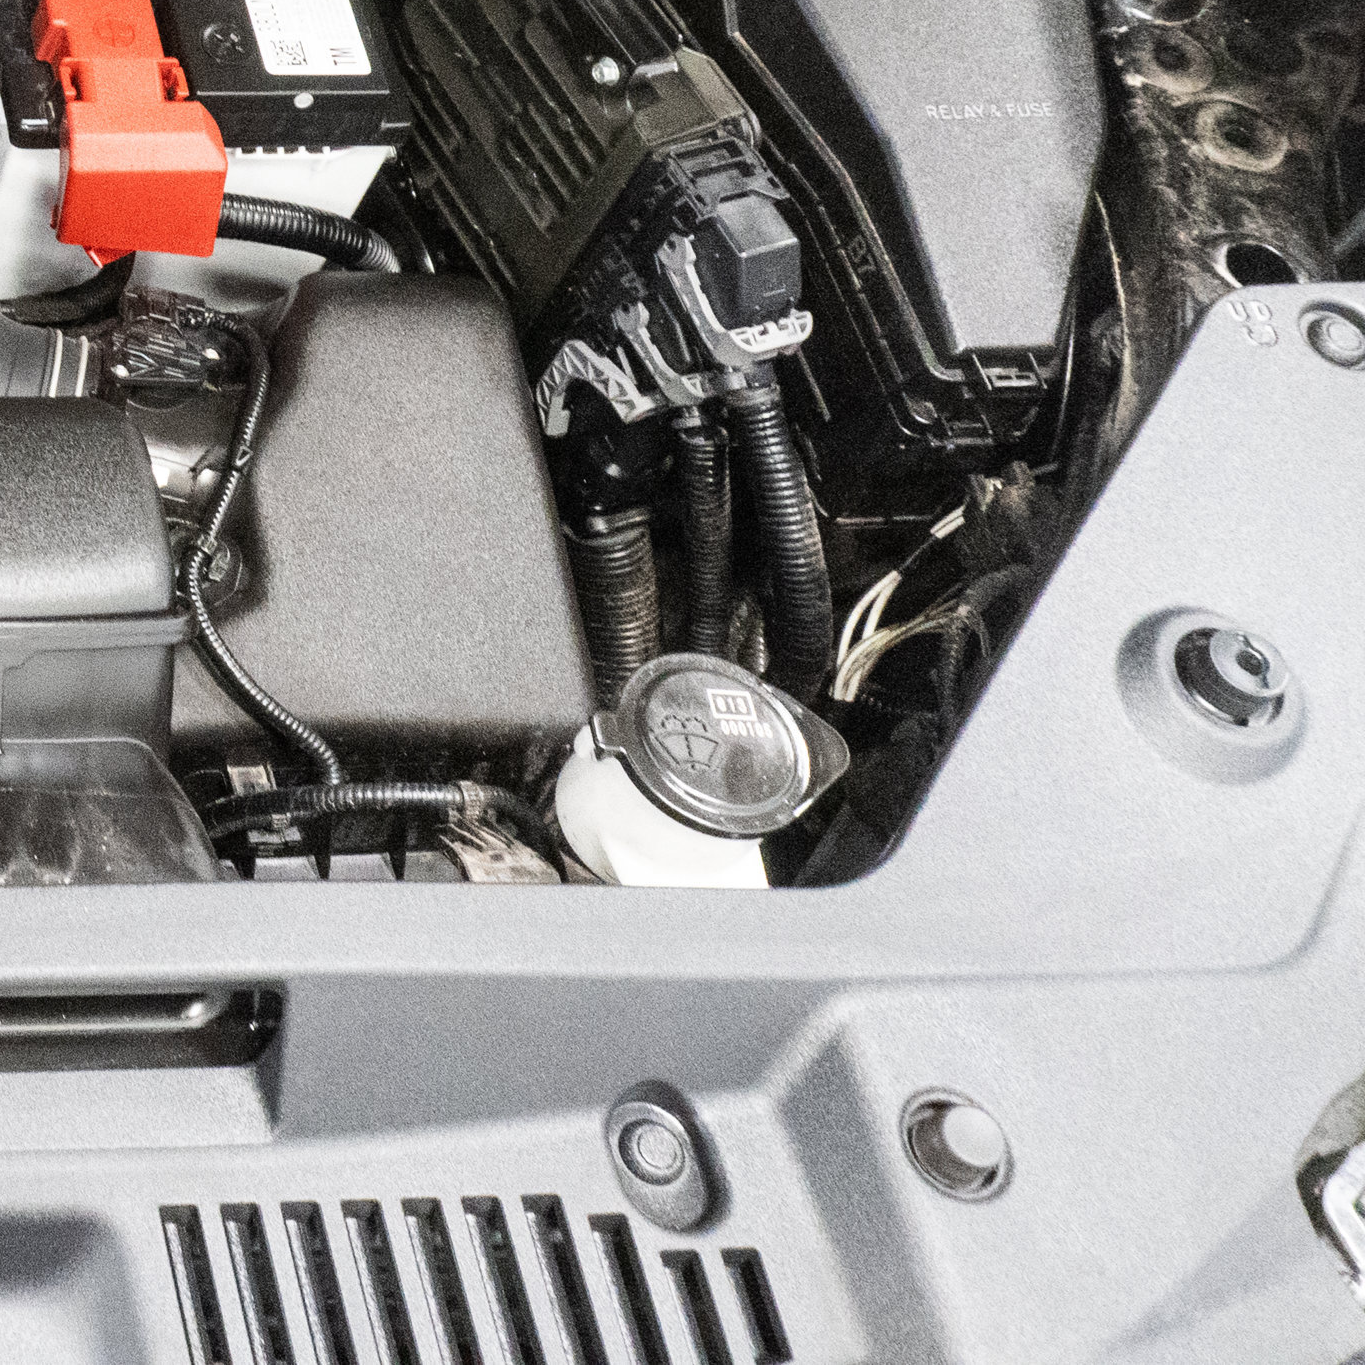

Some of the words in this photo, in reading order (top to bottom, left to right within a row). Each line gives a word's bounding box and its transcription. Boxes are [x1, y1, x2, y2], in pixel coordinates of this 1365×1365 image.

[328, 46, 357, 65] TM
[925, 104, 985, 120] RELAY
[990, 104, 1001, 117] &
[1005, 102, 1053, 118] FUSE
[1226, 300, 1273, 322] UP
